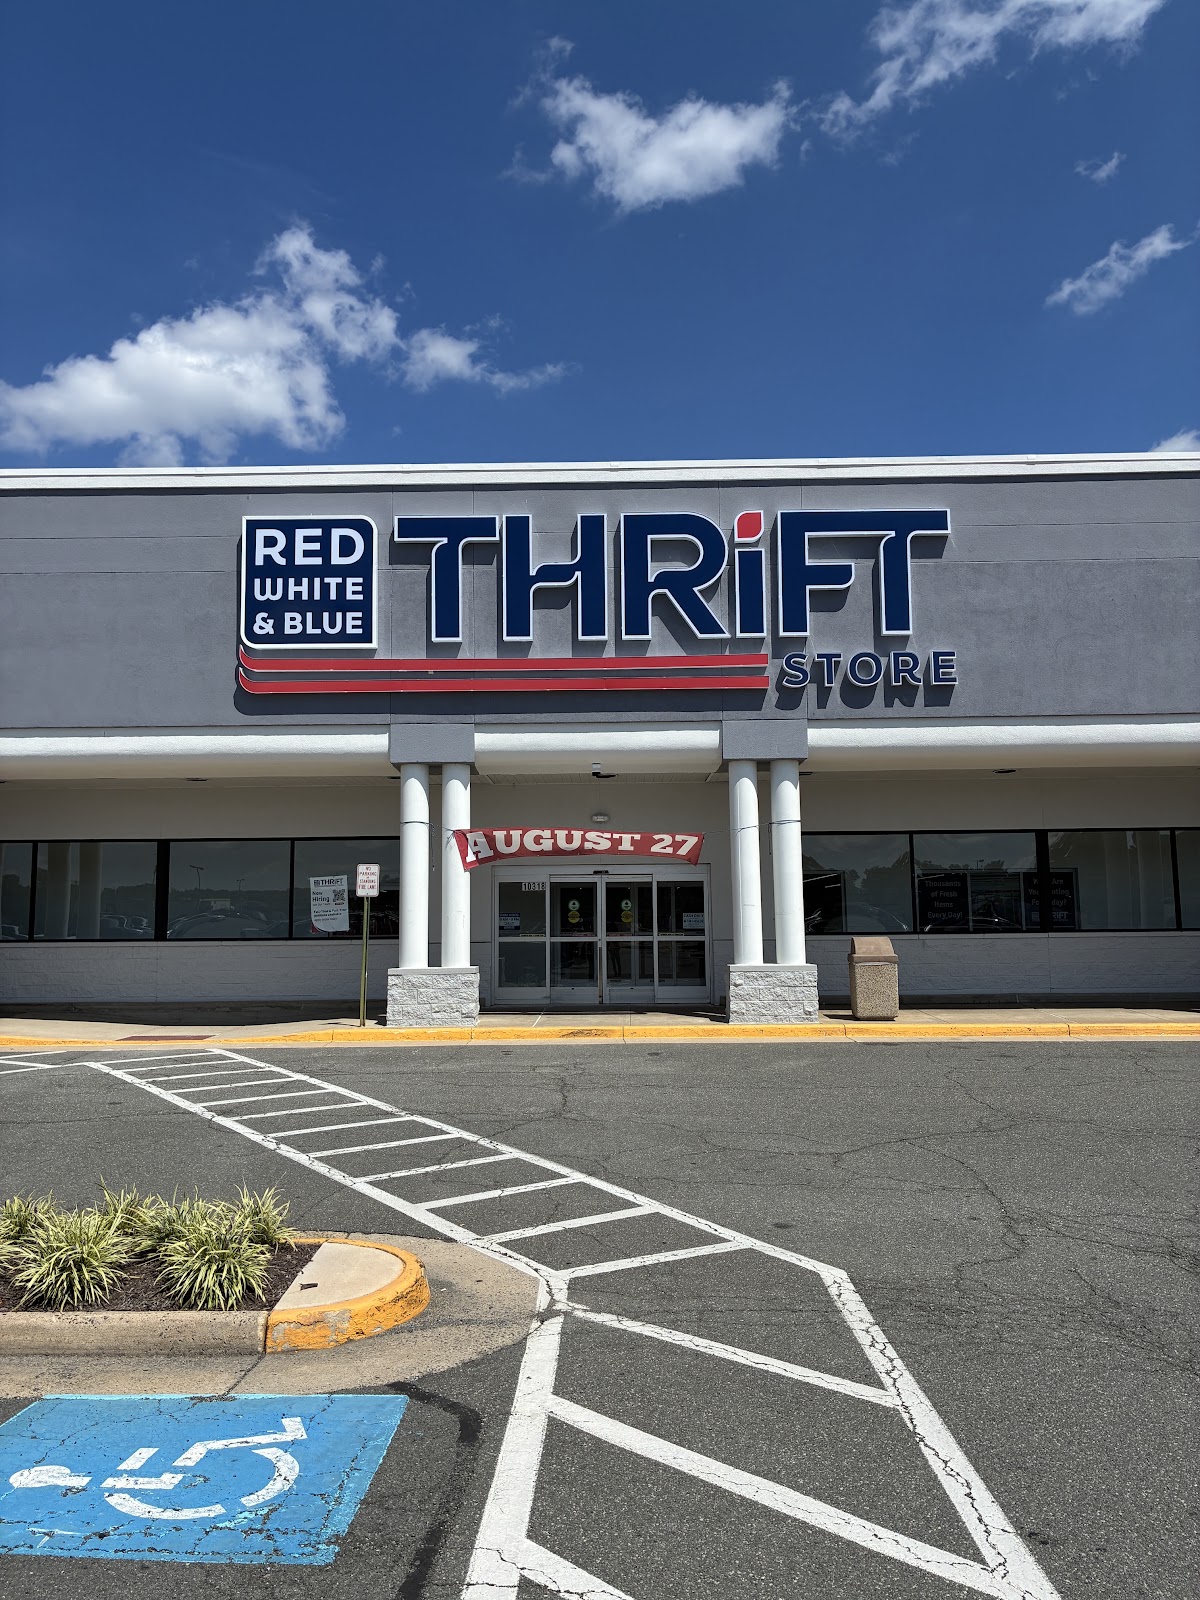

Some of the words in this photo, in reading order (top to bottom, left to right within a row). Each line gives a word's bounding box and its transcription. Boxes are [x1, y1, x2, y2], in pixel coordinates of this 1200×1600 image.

[254, 527, 365, 566] RED
[253, 577, 364, 601] WHITE
[252, 612, 275, 635] &
[284, 611, 363, 635] BLUE
[782, 650, 959, 688] STORE
[465, 829, 641, 863] AUGUST
[650, 834, 699, 856] 27
